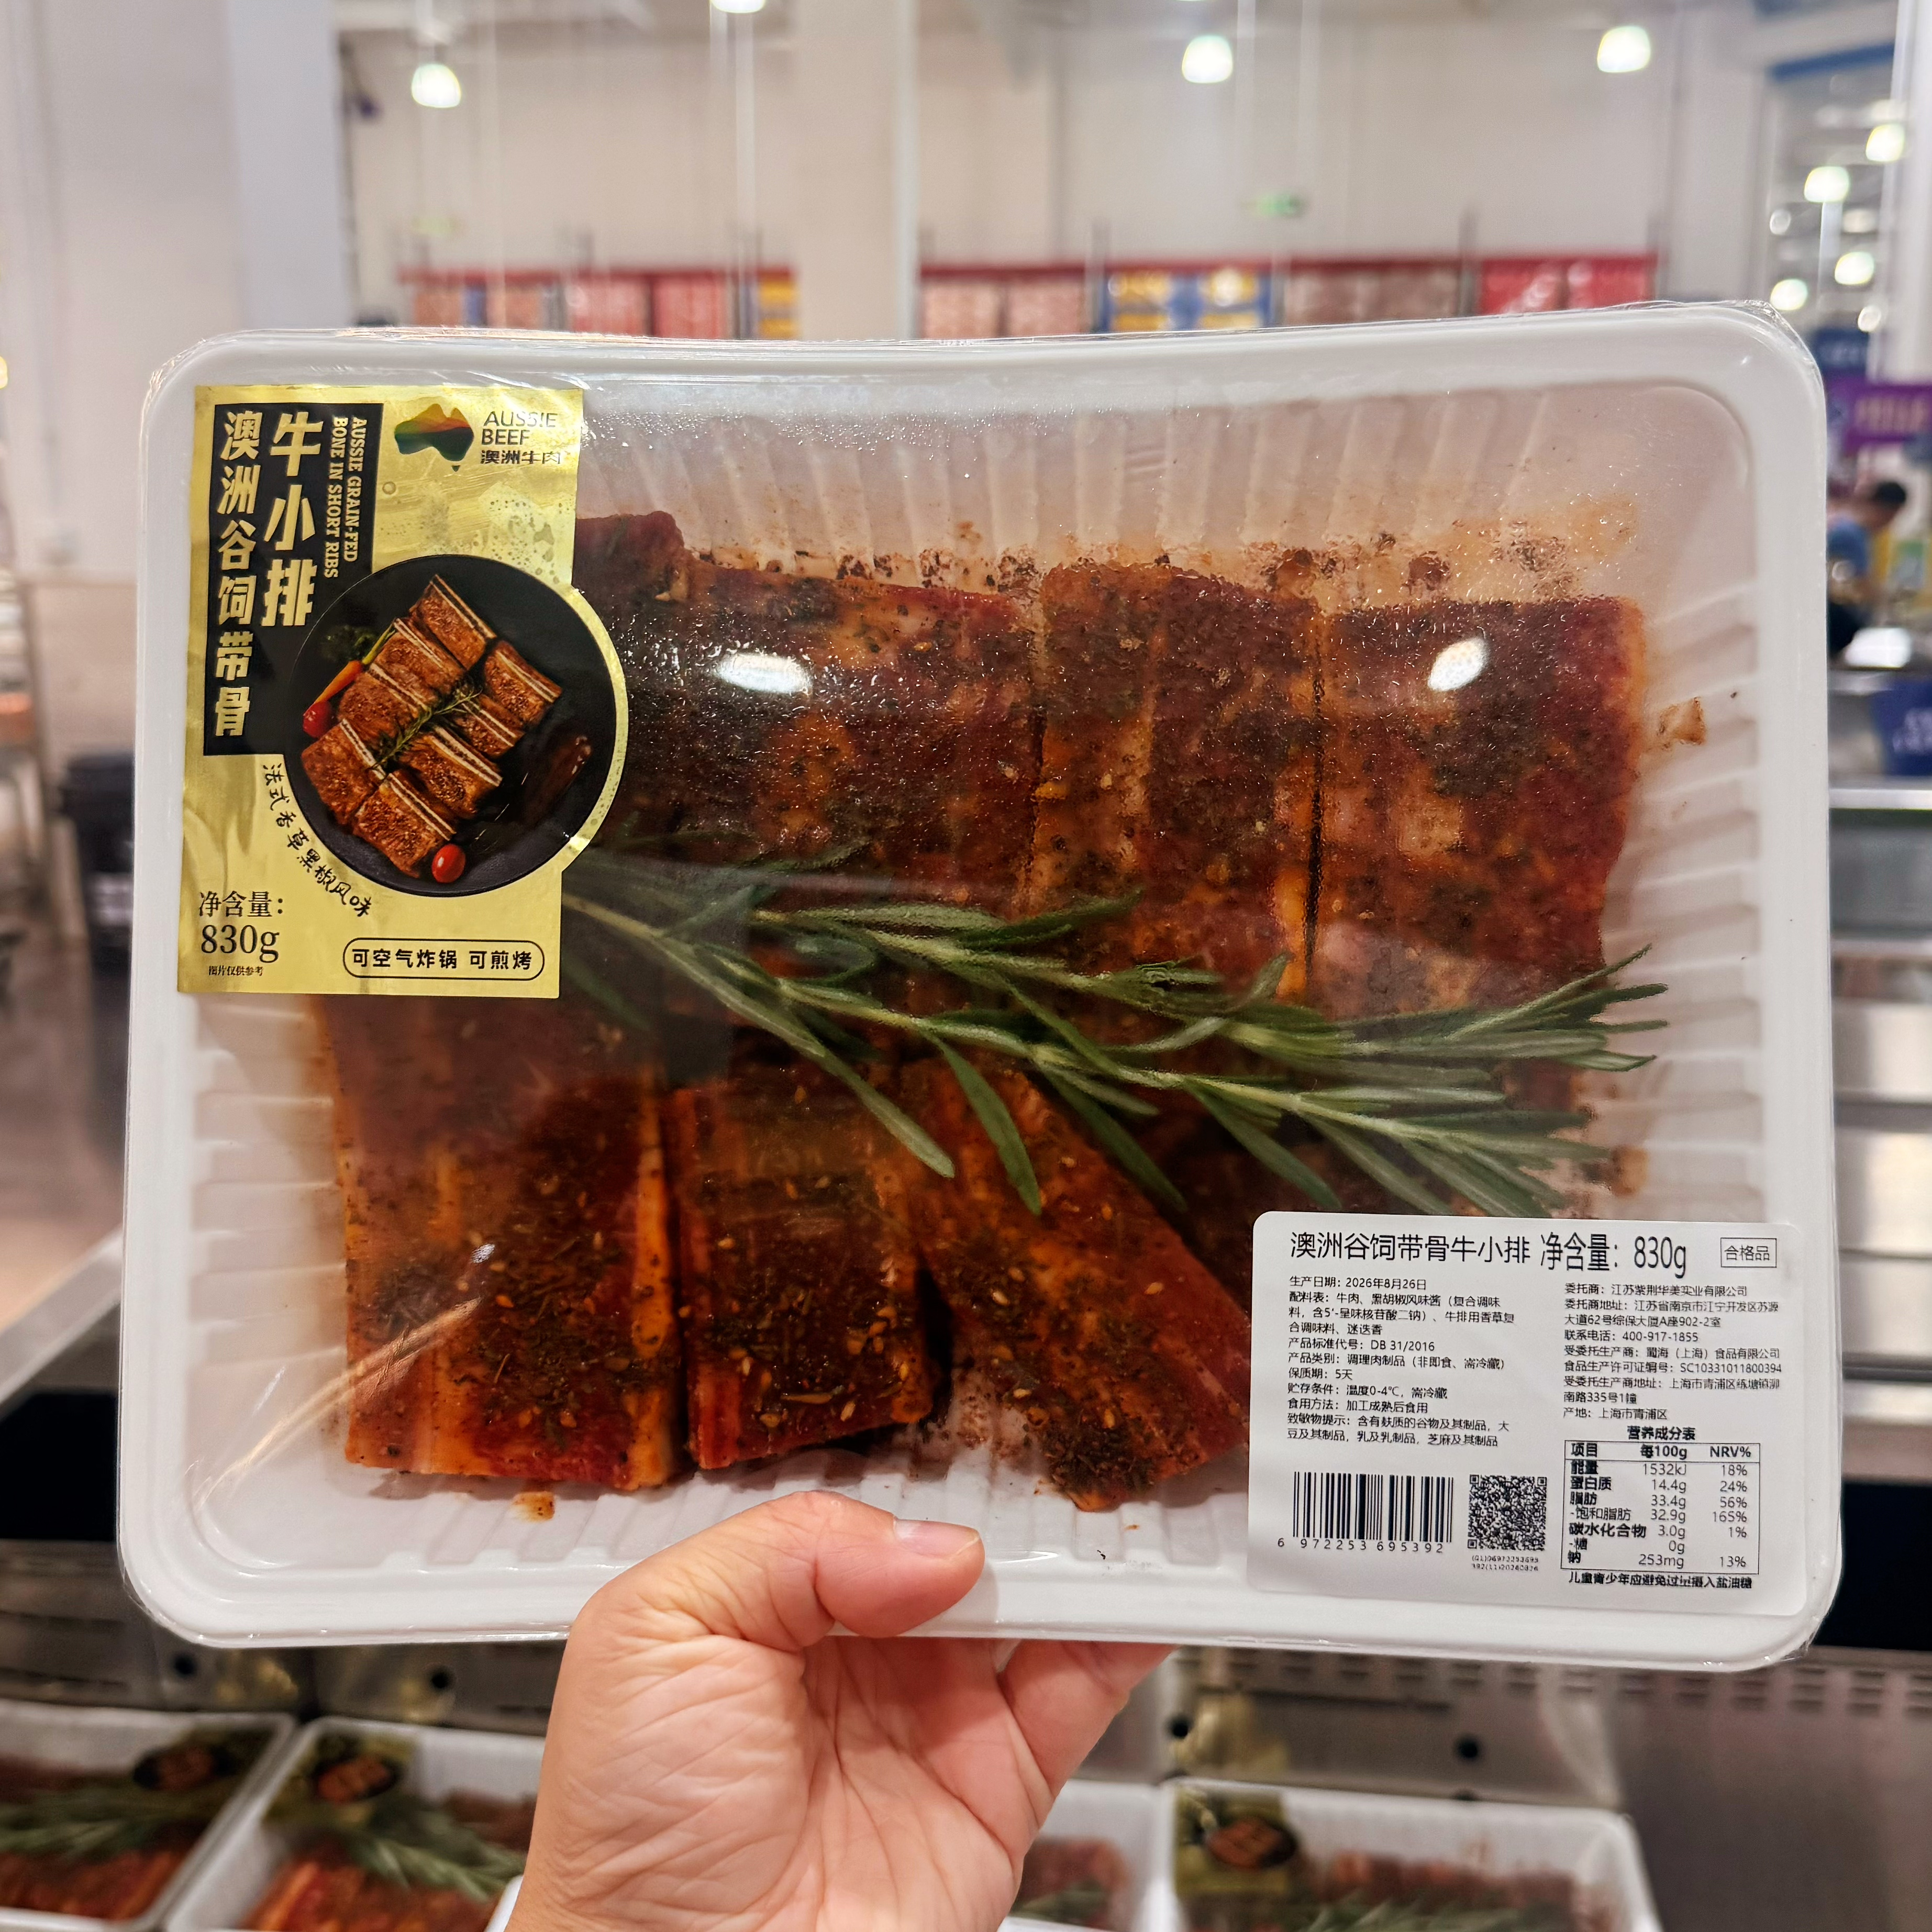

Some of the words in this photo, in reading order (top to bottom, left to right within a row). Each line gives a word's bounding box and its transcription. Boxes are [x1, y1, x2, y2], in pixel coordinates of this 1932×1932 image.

[483, 410, 558, 428] AUSSIE
[330, 417, 349, 459] BONE
[348, 417, 367, 472] AUSSIE
[481, 428, 531, 446] BEEF
[480, 450, 561, 464] 澳洲牛肉
[329, 462, 344, 480] IN
[262, 411, 323, 627] 牛小排
[326, 484, 343, 538] SHORT
[343, 475, 362, 562] GRAIN-FED
[324, 541, 340, 579] RIBS
[215, 410, 262, 737] 澳洲谷饲带骨
[263, 762, 372, 917] 法式香草黑椒风味
[199, 890, 283, 918] 净含量：
[201, 924, 280, 963] 830g
[352, 948, 458, 969] 可空气炸锅
[469, 950, 532, 970] 可煎烤
[1290, 1231, 1530, 1264] 澳洲谷饲带骨牛小排
[1724, 1245, 1770, 1261] 合格品
[1390, 1340, 1435, 1352] 31/2016
[1627, 1425, 1695, 1440] 营养成分表
[1571, 1442, 1597, 1457] 项目
[1639, 1444, 1687, 1460] 每100g
[1709, 1446, 1751, 1458] NRV%
[1570, 1459, 1598, 1475] 能量
[1642, 1463, 1687, 1475] 1532kJ
[1722, 1464, 1748, 1476] 18%
[1570, 1475, 1612, 1491] 蛋白质
[1651, 1478, 1686, 1494] 14.4g
[1719, 1480, 1748, 1492] 24%
[1570, 1491, 1597, 1505] 脂肪
[1651, 1494, 1686, 1509] 33.4g
[1720, 1496, 1748, 1508] 56%
[1650, 1508, 1686, 1524] 32.9g
[1713, 1511, 1747, 1523] 165%
[1569, 1522, 1647, 1538] 碳水化合物
[1658, 1524, 1685, 1540] 3.0g
[1729, 1526, 1747, 1538] 1%
[1669, 1540, 1685, 1555] 0g
[1567, 1550, 1581, 1564] 钠
[1638, 1553, 1684, 1570] 253mg
[1720, 1556, 1746, 1568] 13%
